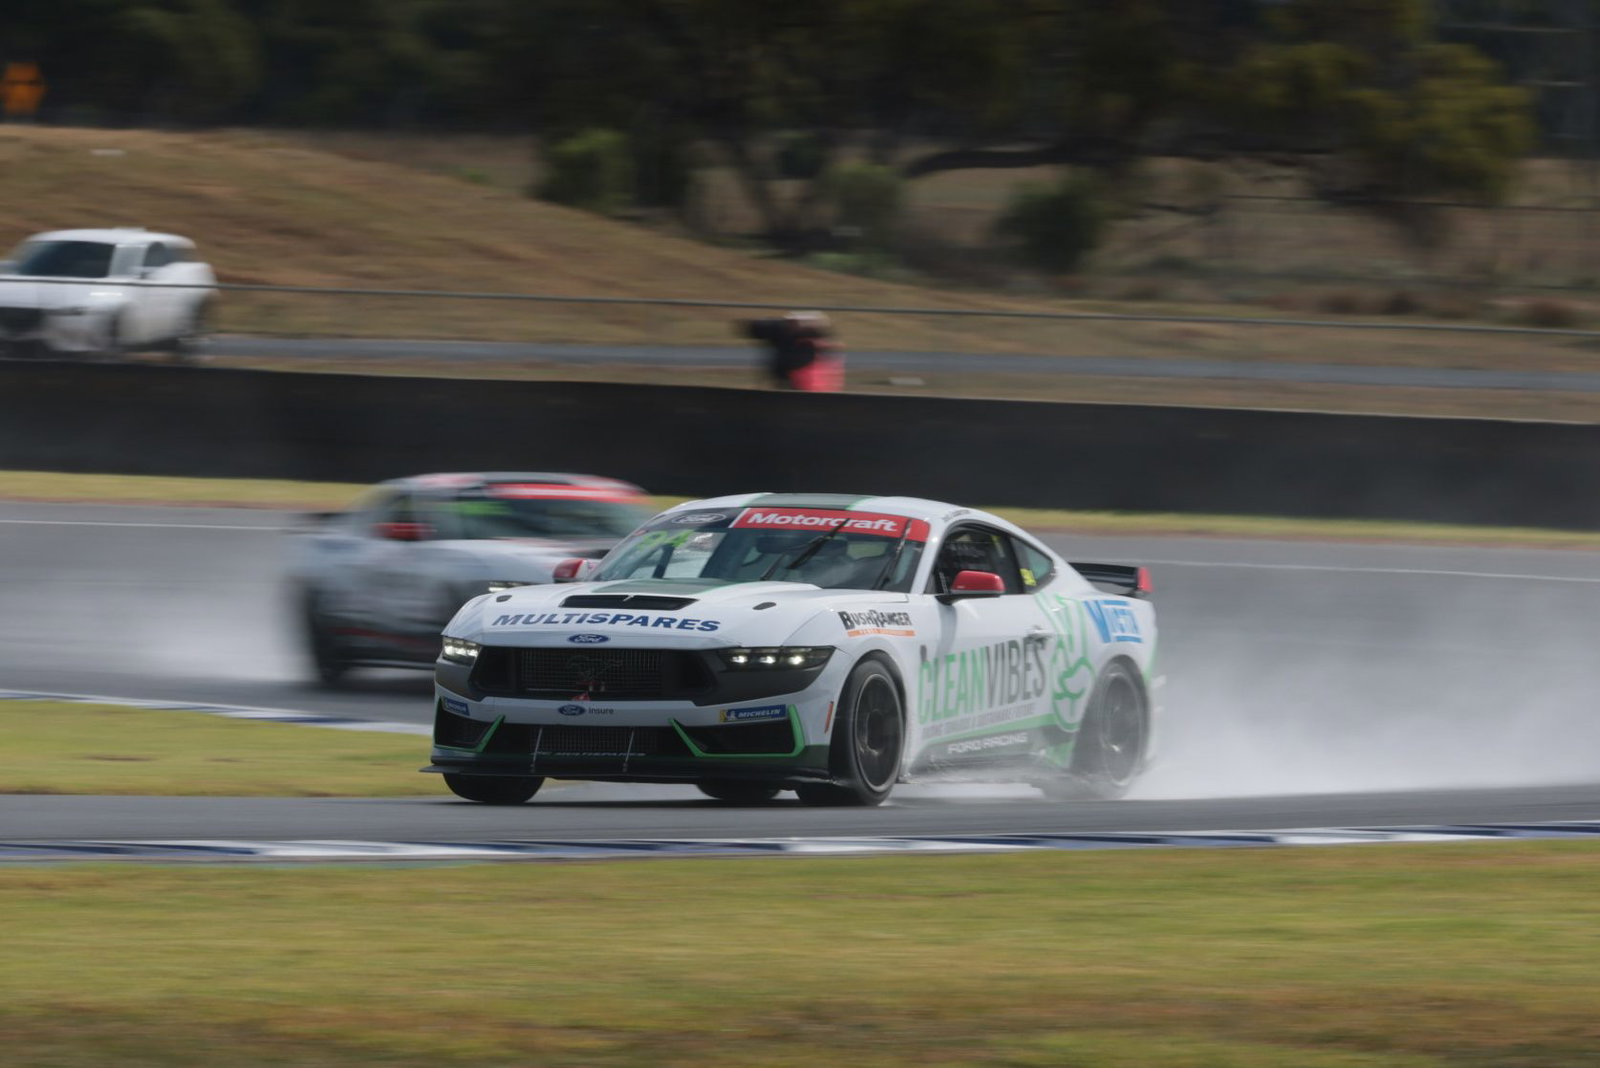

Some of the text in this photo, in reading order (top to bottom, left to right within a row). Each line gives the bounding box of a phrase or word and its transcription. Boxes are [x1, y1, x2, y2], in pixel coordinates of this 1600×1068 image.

[746, 511, 898, 533] Motorcraft
[491, 612, 721, 632] MULTISPARES
[738, 708, 781, 718] MICHELIN
